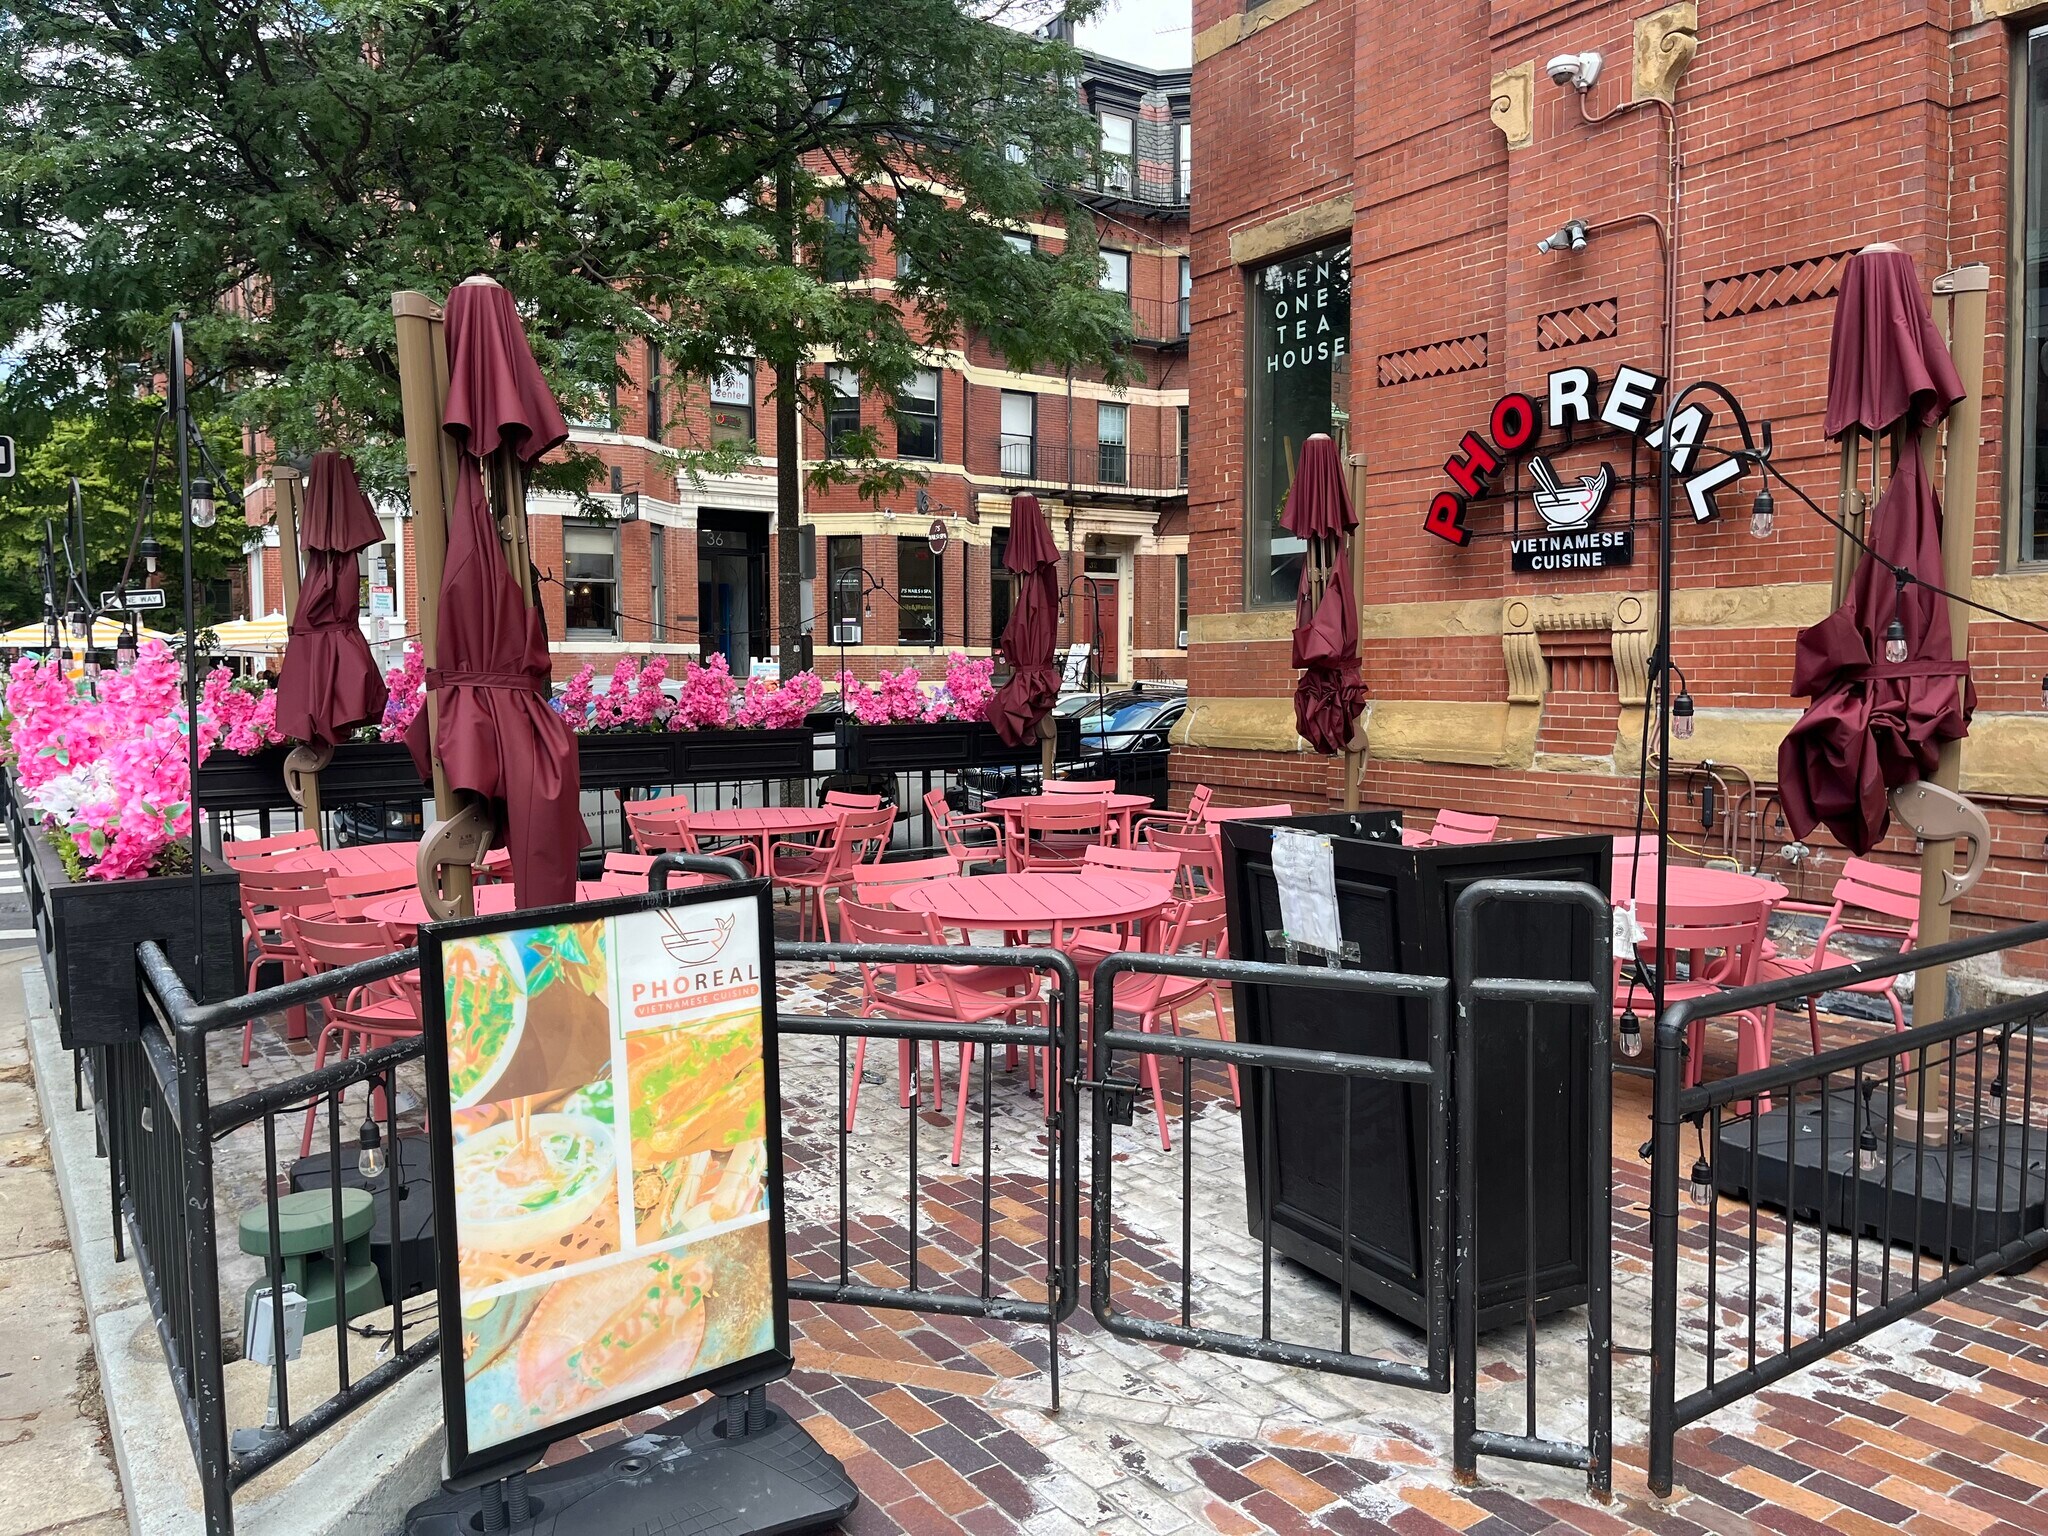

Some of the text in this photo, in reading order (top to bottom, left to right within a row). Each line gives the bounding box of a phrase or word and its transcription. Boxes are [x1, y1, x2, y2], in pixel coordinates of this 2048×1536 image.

[1276, 261, 1329, 295] TEN
[1275, 287, 1328, 320] ONE
[1276, 314, 1330, 344] TEA
[1267, 336, 1345, 374] HOUSE
[715, 388, 745, 400] Center
[706, 532, 724, 546] 36
[1510, 531, 1625, 554] VIETNAMESE
[1531, 552, 1603, 570] CUISINE
[632, 964, 759, 1002] PHOREAL
[638, 987, 756, 1015] VIETNAMESE CUISINE
